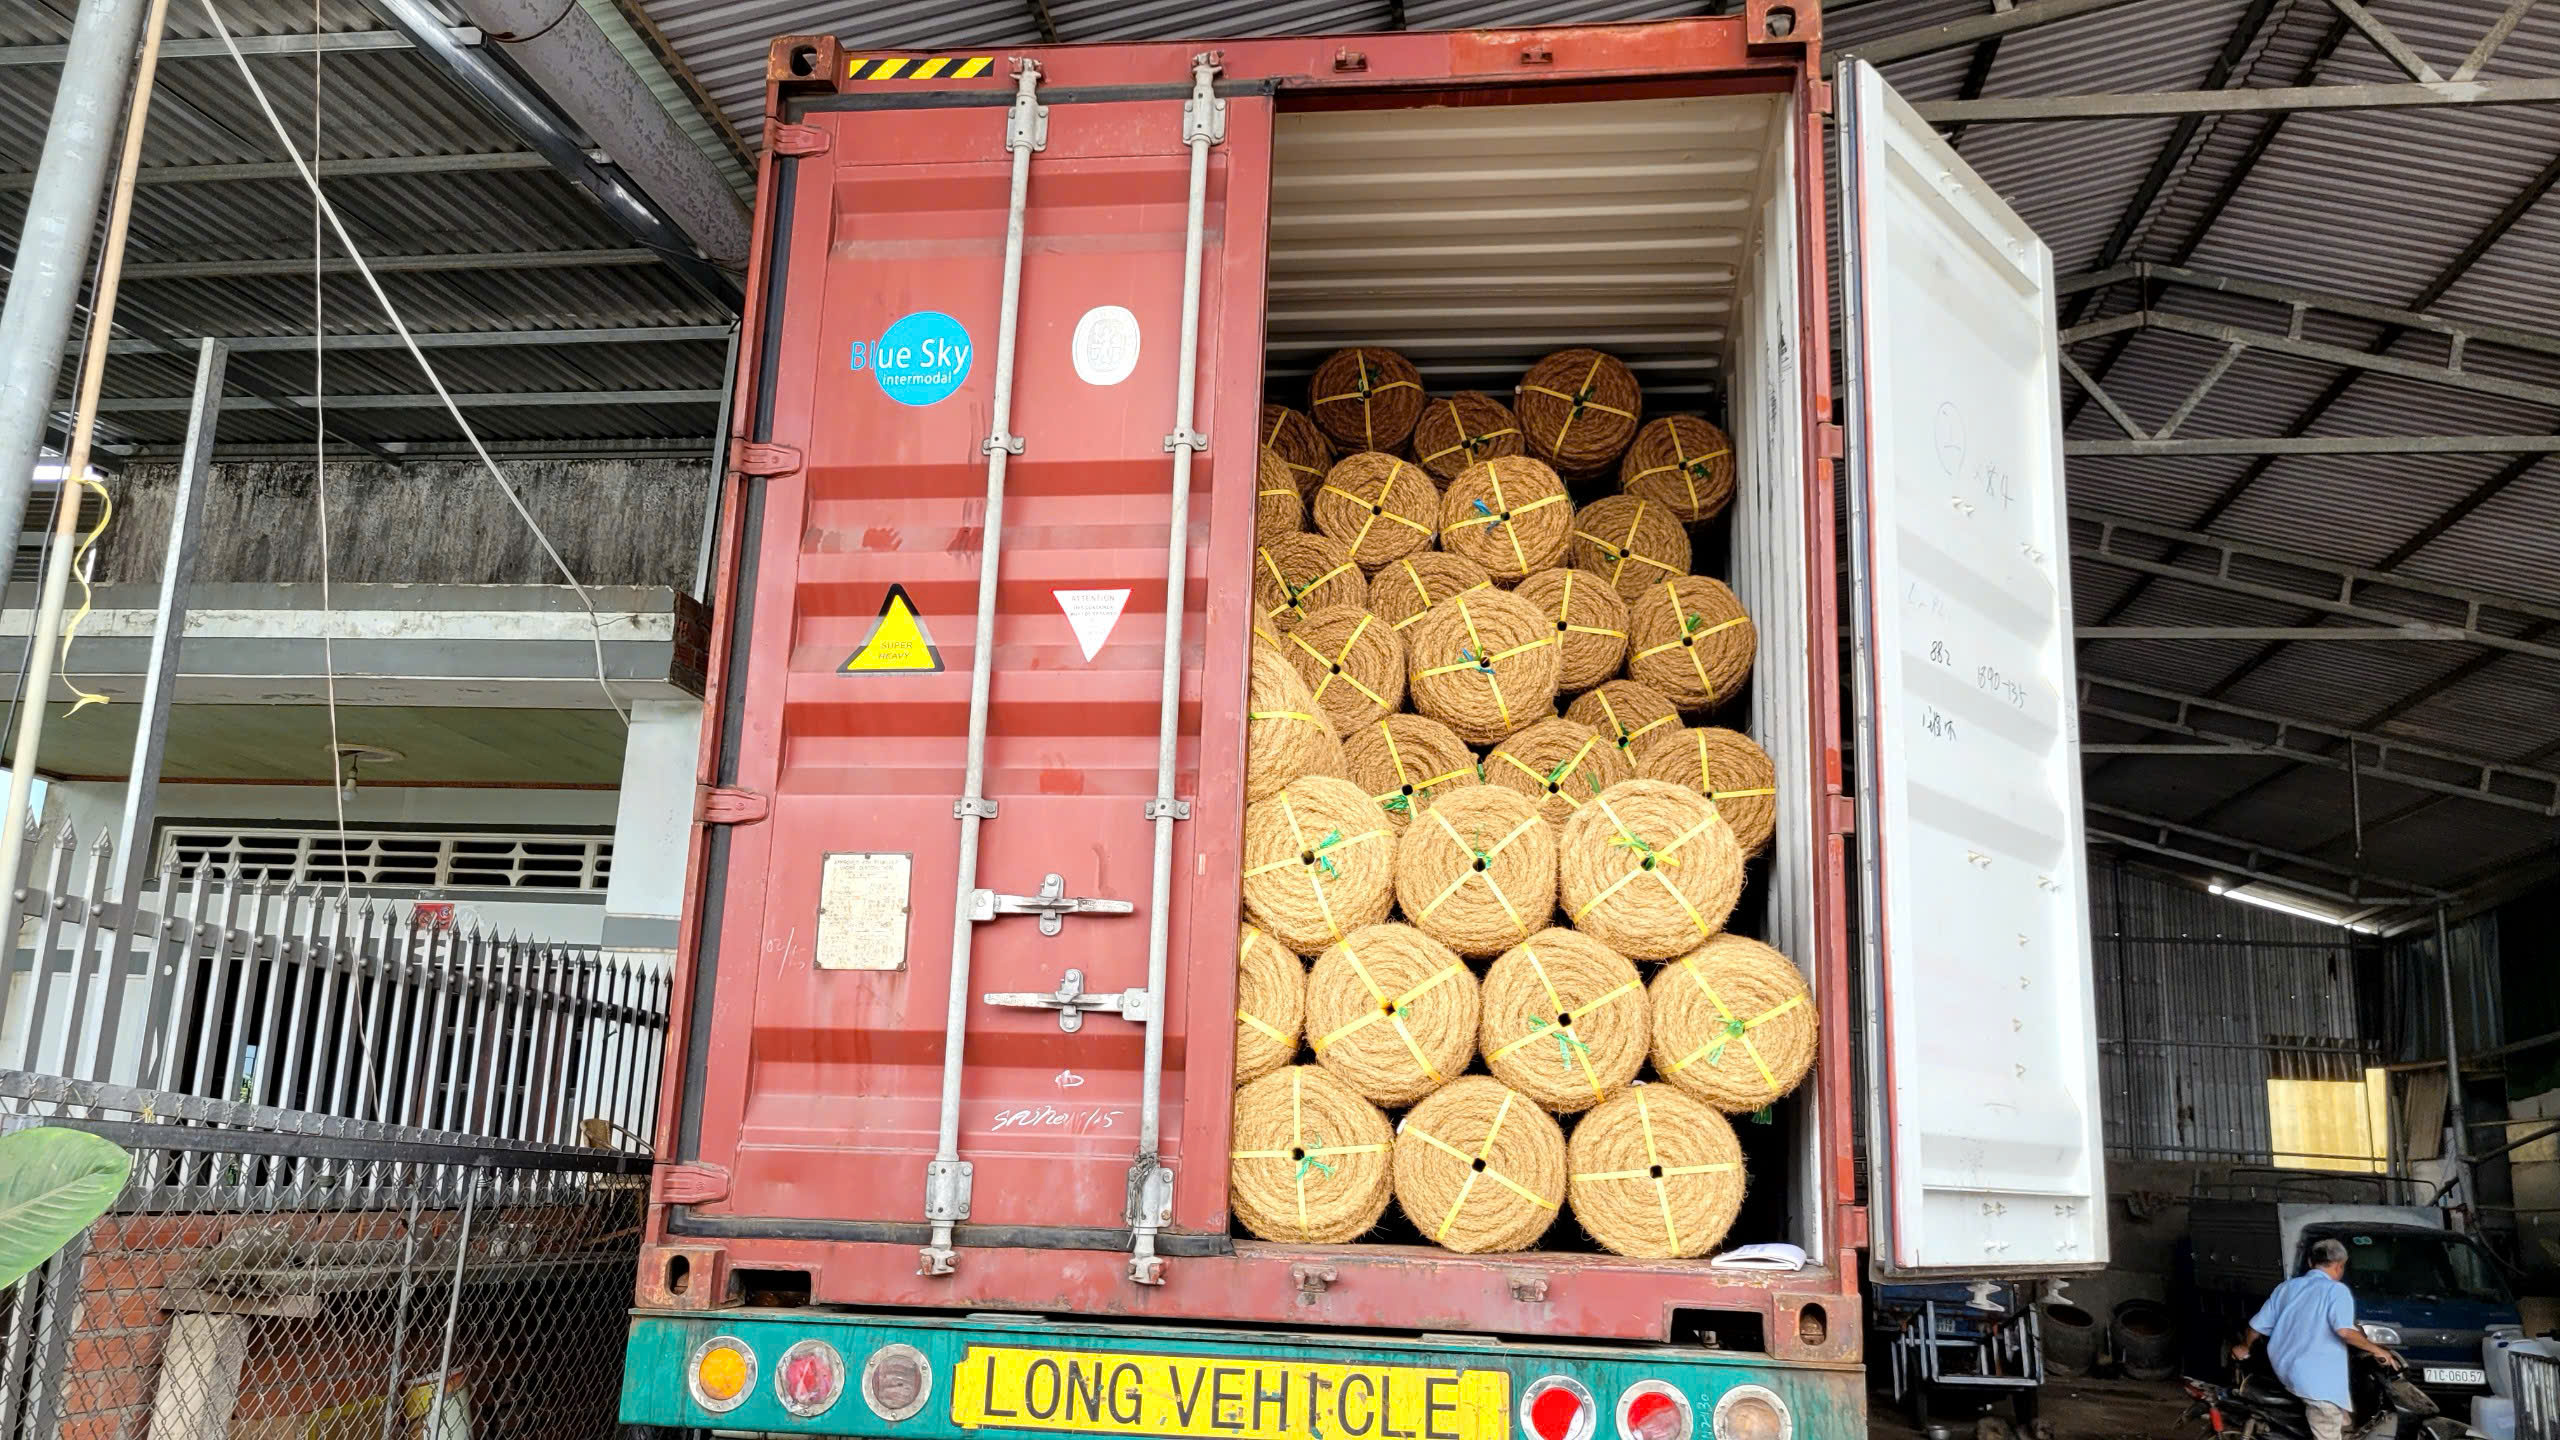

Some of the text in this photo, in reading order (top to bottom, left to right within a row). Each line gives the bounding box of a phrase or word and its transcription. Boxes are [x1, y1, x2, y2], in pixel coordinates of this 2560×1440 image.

[850, 338, 969, 374] Blue Sky
[883, 371, 951, 386] intermodal
[881, 641, 912, 649] SUPER
[984, 1356, 1460, 1439] LONG VEHICLE
